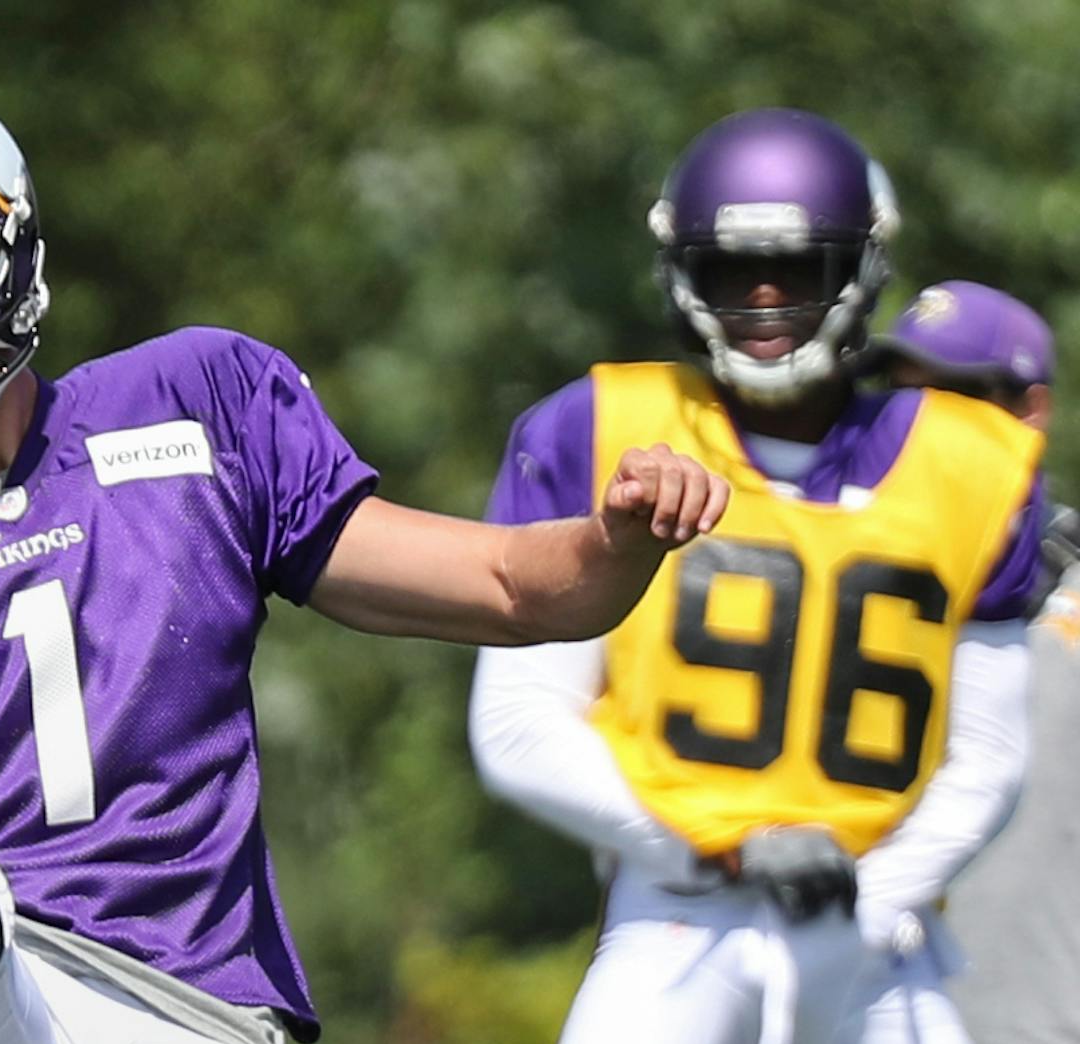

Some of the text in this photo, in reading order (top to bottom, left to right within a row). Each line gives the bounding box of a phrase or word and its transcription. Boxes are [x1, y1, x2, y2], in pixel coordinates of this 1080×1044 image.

[102, 443, 197, 467] verizon
[3, 579, 95, 826] 1
[663, 538, 948, 793] 96
